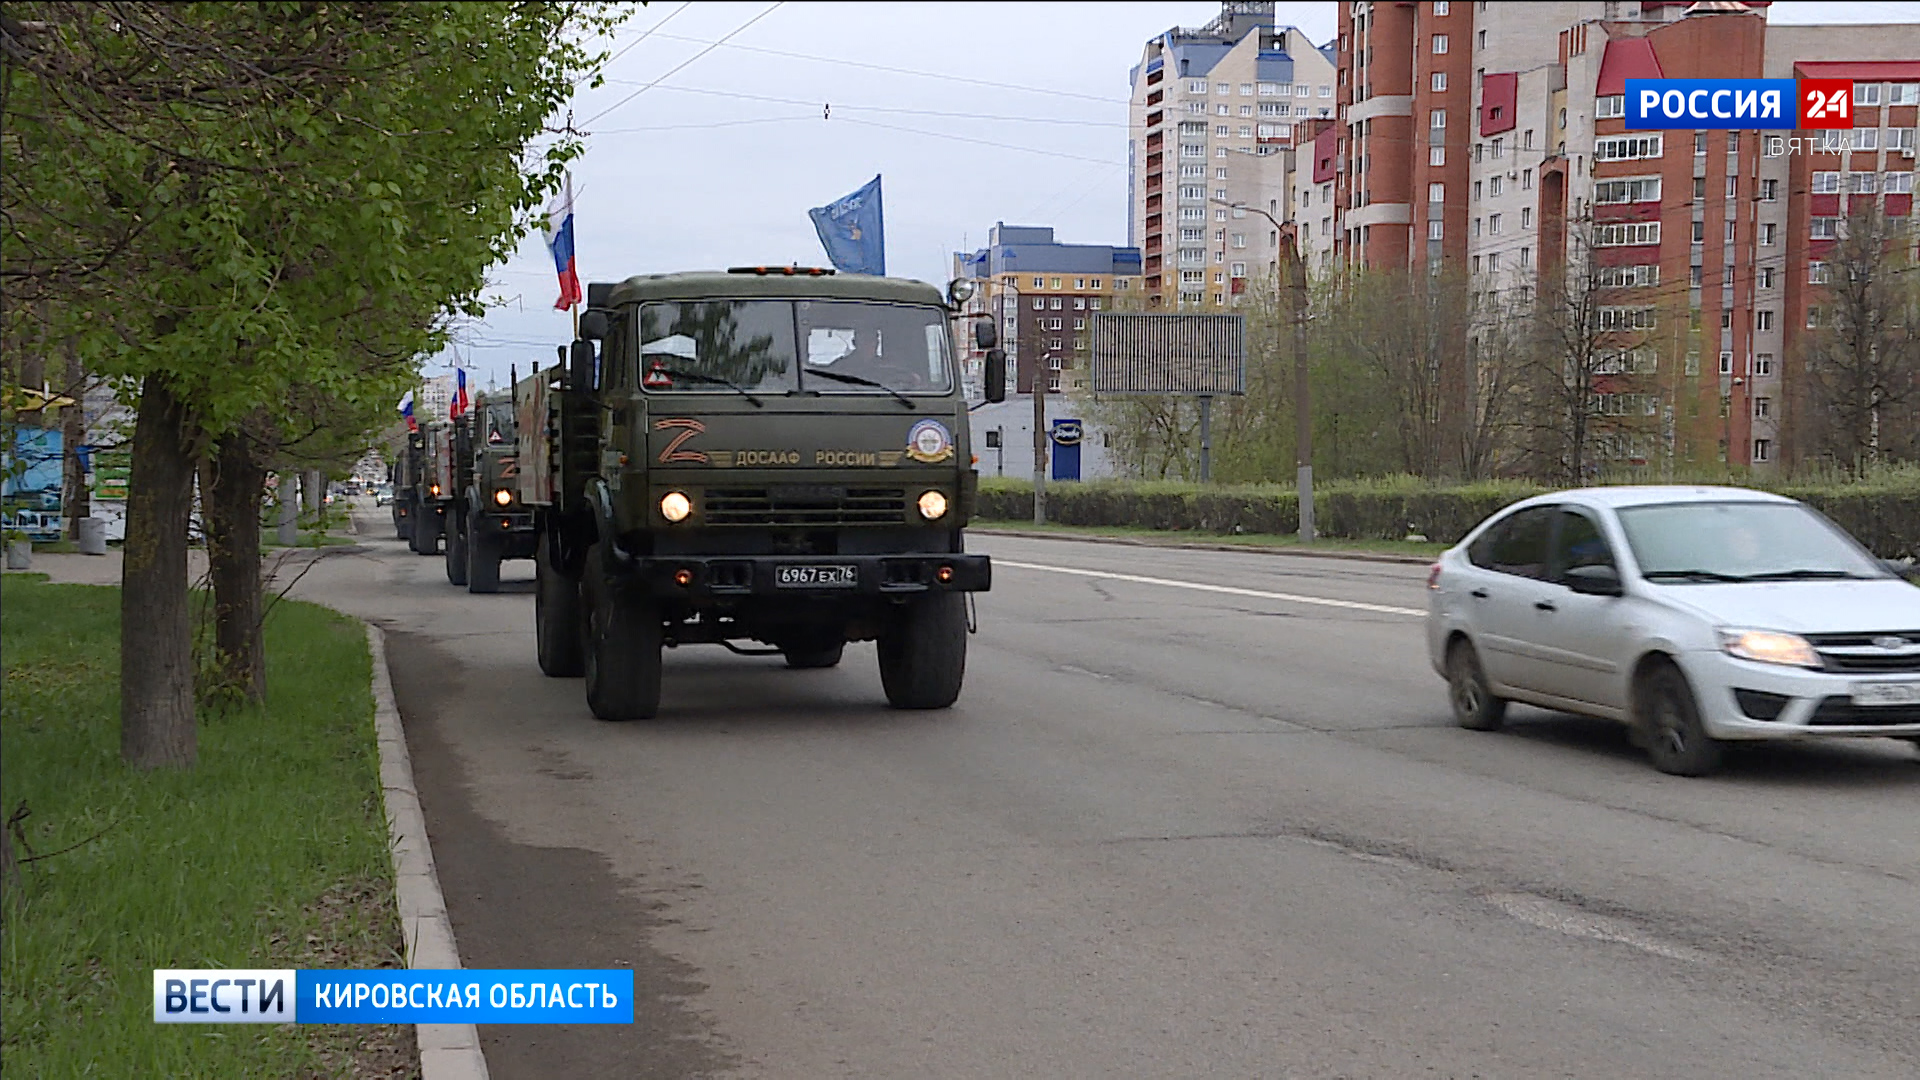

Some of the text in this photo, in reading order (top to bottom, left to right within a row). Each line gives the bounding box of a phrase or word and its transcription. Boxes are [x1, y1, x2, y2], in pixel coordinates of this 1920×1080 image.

[653, 418, 708, 463] Z
[736, 450, 876, 466] ДОСААФ РОССИИ
